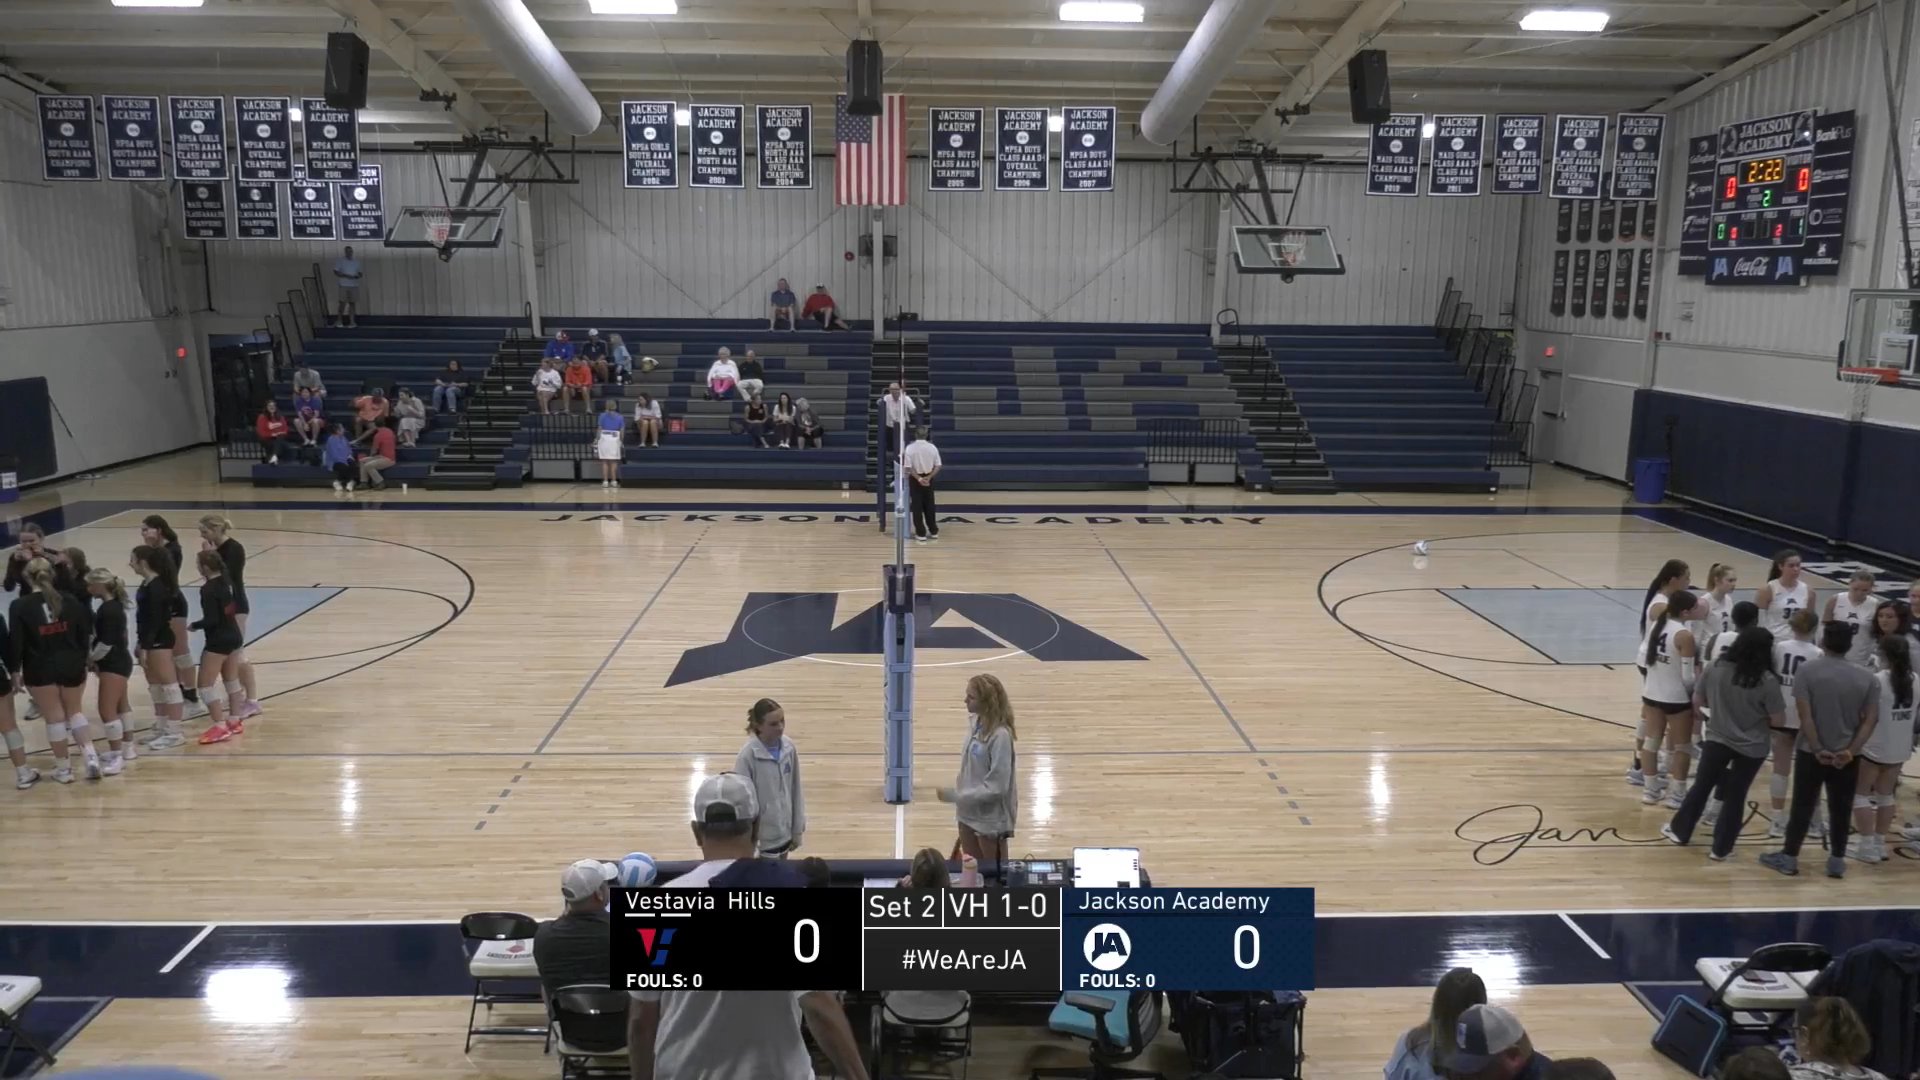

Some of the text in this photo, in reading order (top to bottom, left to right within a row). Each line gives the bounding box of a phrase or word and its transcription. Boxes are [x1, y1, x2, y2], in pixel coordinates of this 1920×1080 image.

[47, 100, 84, 108] JACKSON
[112, 100, 150, 108] JACKSON
[177, 100, 215, 108] JACKSON
[243, 101, 281, 109] JACKSON
[631, 105, 667, 113] JACKSON
[698, 108, 735, 117] JACKSON
[766, 109, 801, 117] JACKSON
[48, 111, 85, 120] ACADEMY
[112, 111, 151, 120] ACADEMY
[178, 111, 215, 119] ACADEMY
[243, 112, 282, 120] ACADEMY
[310, 113, 349, 122] ACADEMY
[939, 112, 975, 120] JACKSON
[1005, 112, 1041, 120] JACKSON
[1071, 110, 1107, 119] JACKSON
[631, 115, 667, 124] ACADEMY
[698, 119, 736, 128] ACADEMY
[766, 119, 802, 127] ACADEMY
[1441, 118, 1478, 127] JACKSON
[1503, 119, 1539, 128] JACKSON
[1564, 120, 1599, 128] JACKSON
[1623, 118, 1659, 127] JACKSON
[938, 123, 975, 131] ACADEMY
[1004, 122, 1041, 130] ACADEMY
[1070, 121, 1108, 130] ACADEMY
[1740, 117, 1793, 138] JACKSON
[1378, 128, 1416, 136] ACADEMY
[1439, 128, 1477, 136] ACADEMY
[1503, 129, 1539, 137] ACADEMY
[1562, 129, 1599, 137] ACADEMY
[1622, 127, 1658, 136] ACADEMY
[1816, 126, 1852, 142] BankPlus
[1737, 133, 1792, 154] ACADEMY
[636, 160, 666, 168] OVERALL
[933, 160, 954, 168] CLASS
[697, 167, 737, 175] CHAMPIONS
[1068, 170, 1107, 178] CHAMPIONS
[1748, 159, 1783, 183] 2:22
[1798, 168, 1809, 191] 0
[1726, 176, 1737, 198] 0
[1762, 190, 1773, 207] 2
[1717, 224, 1725, 239] 0
[1775, 224, 1783, 236] 2
[539, 513, 871, 523] JACKSON
[936, 515, 1265, 525] ACADEMY
